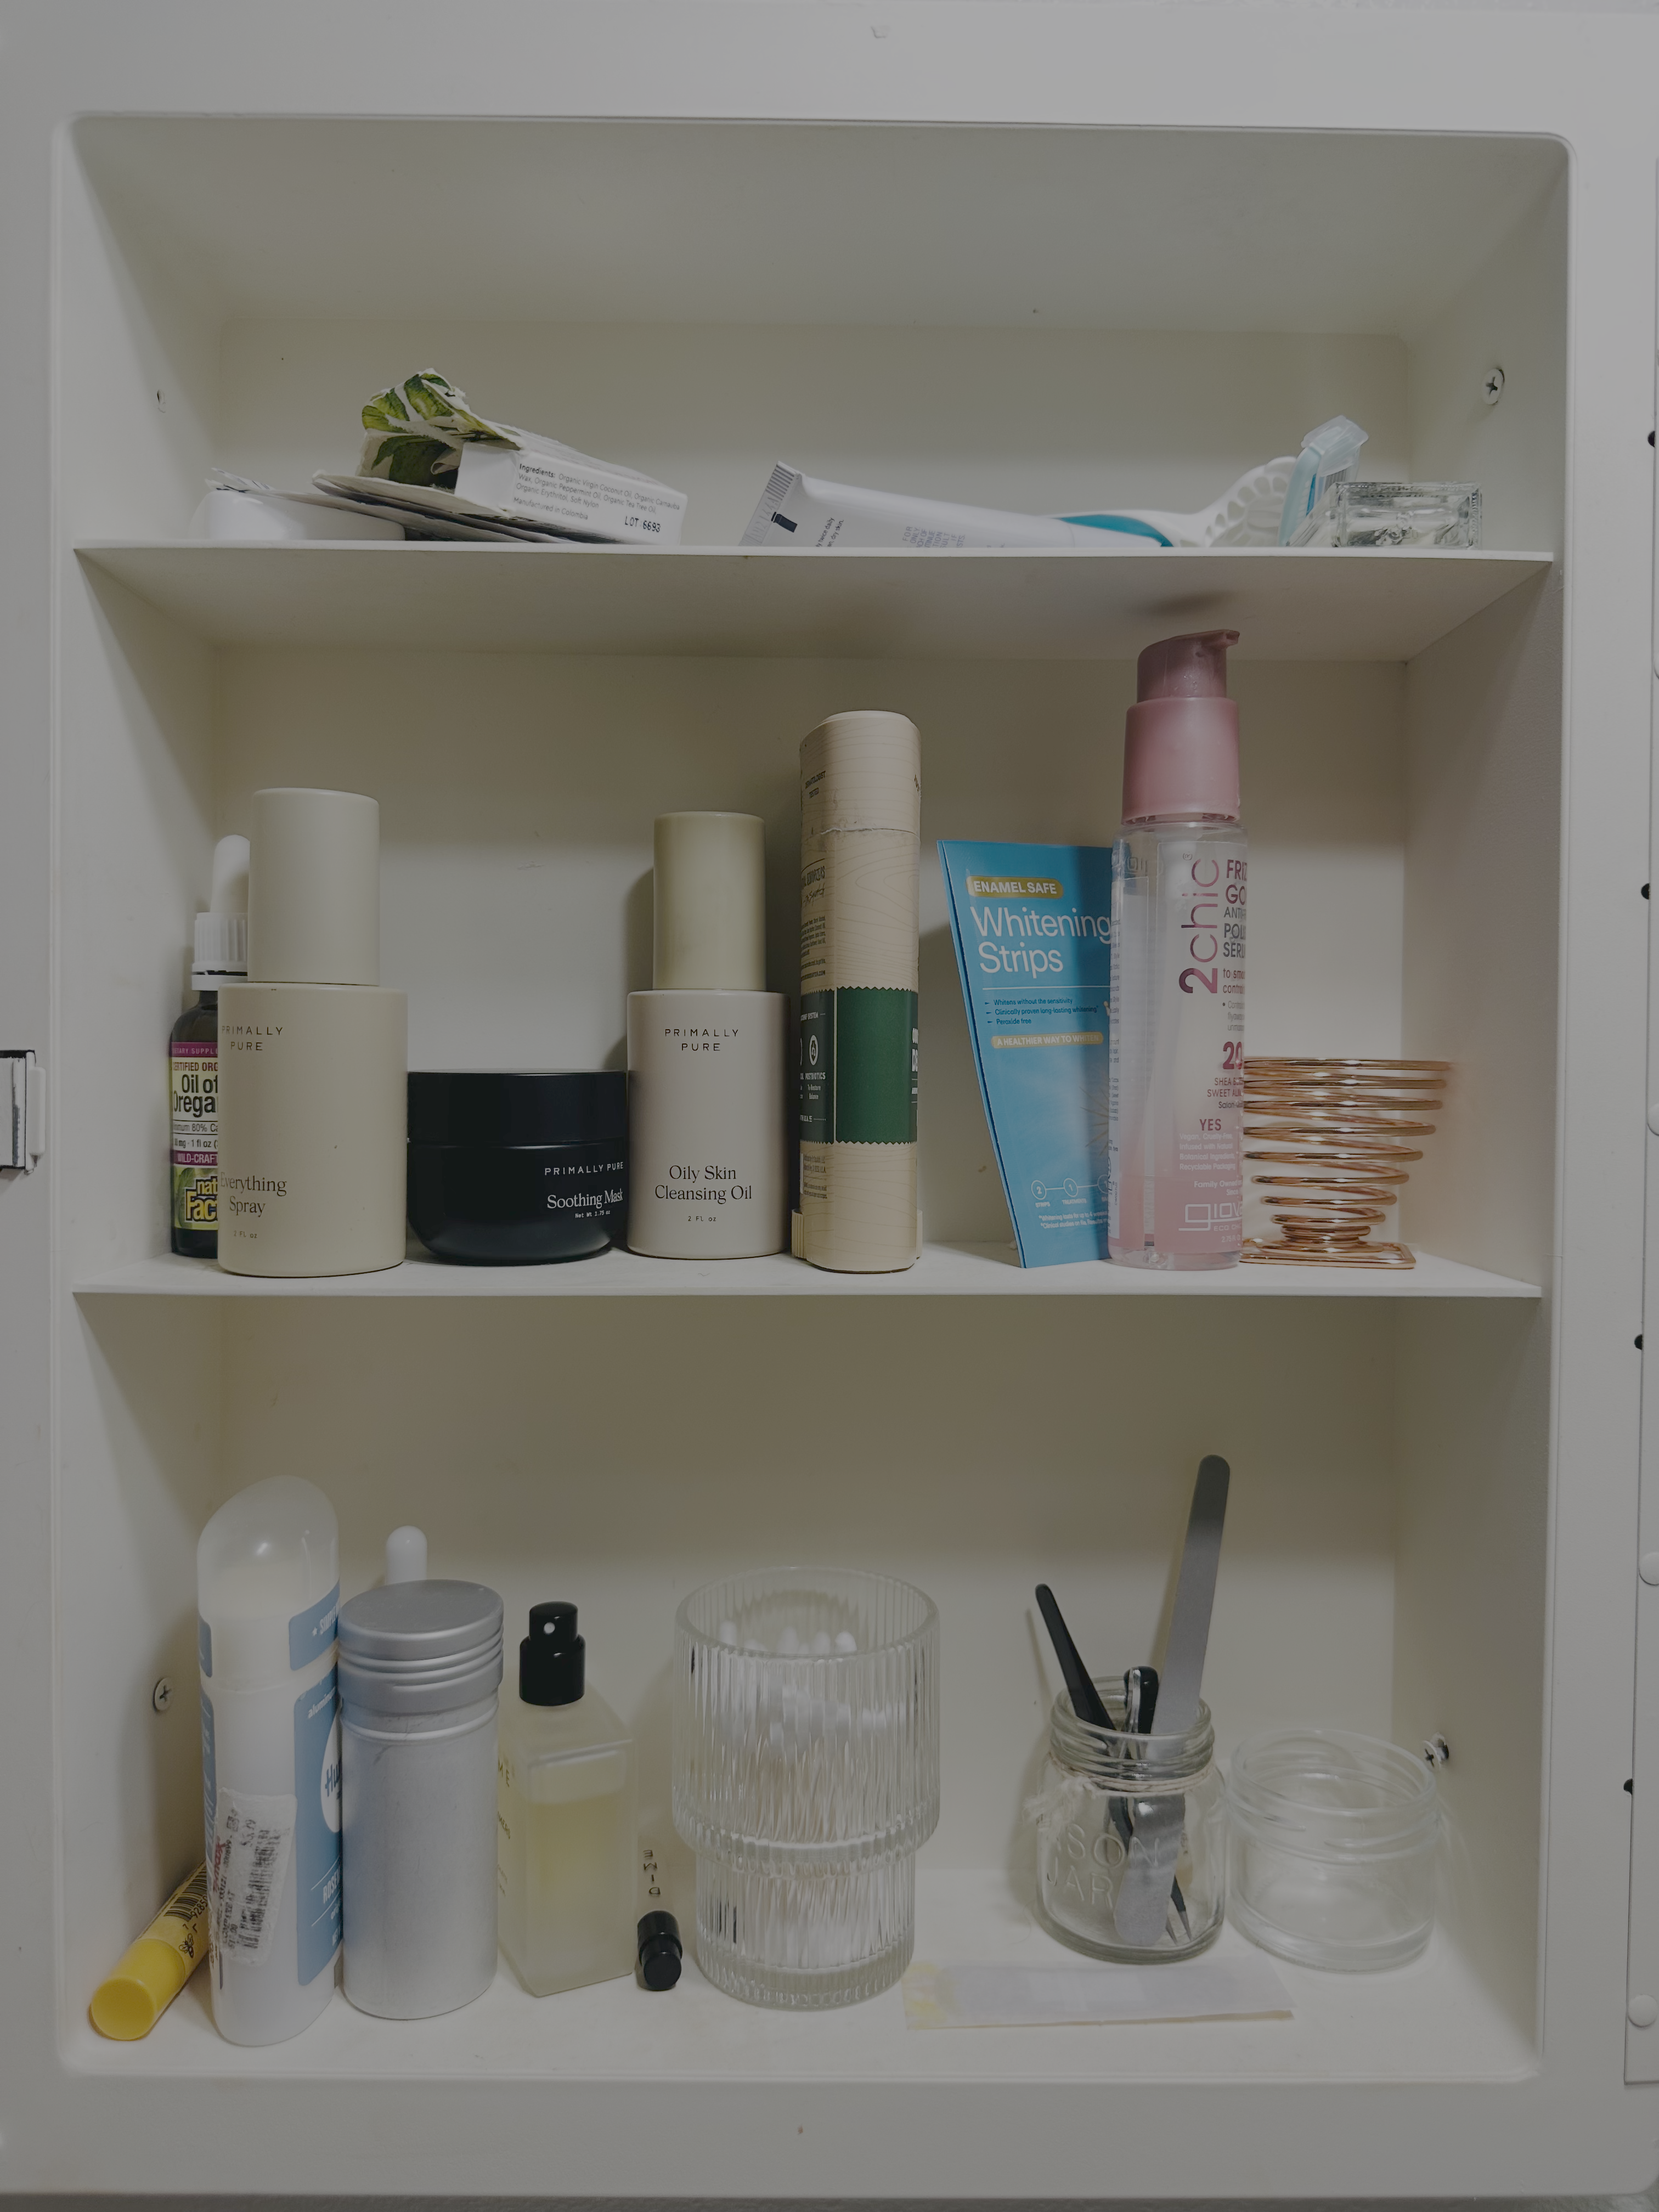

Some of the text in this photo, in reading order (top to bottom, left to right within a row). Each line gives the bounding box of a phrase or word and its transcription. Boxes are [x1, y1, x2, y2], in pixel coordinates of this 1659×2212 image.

[518, 473, 532, 483] Wax,
[535, 477, 557, 489] Organic
[560, 483, 591, 498] Peppermint
[593, 492, 601, 500] Oil,
[603, 495, 624, 506] Organic
[636, 503, 647, 511] Tree
[519, 464, 555, 478] Ingredients:
[559, 473, 581, 486] Organic
[583, 479, 598, 489] Virgin
[600, 484, 623, 495] Coconut
[634, 493, 658, 505] Organic
[516, 483, 538, 494] Organic
[571, 496, 582, 504] Soft
[583, 499, 599, 509] Nylon
[514, 497, 553, 511] Manufactured
[562, 508, 588, 520] Colombia
[643, 521, 661, 532] 6693
[920, 529, 928, 538] OF
[973, 881, 1057, 894] ENAMEL SAFE
[969, 906, 1111, 945] Whitening
[1179, 859, 1220, 994] 2chic
[978, 941, 1064, 979] Strips
[1223, 968, 1231, 978] to
[1040, 1007, 1071, 1015] long-lasting
[222, 1025, 283, 1035] PRIMALLY
[665, 1029, 738, 1037] PRIMALLY
[230, 1041, 263, 1051] PURE
[681, 1043, 720, 1051] PURE
[1003, 1037, 1042, 1046] HEALTHIER
[1043, 1036, 1060, 1044] WAY
[1072, 1034, 1099, 1043] WHITEN
[182, 1074, 199, 1093] Oil
[1207, 1089, 1230, 1097] SWEET
[173, 1090, 218, 1118] Orega
[192, 1123, 207, 1132] 80%
[1199, 1119, 1221, 1131] YES
[545, 1161, 623, 1176] PRIMALLY PURE
[669, 1165, 737, 1183] Oily Skin
[1180, 1163, 1212, 1171] Recyclable
[221, 1172, 286, 1197] Everything
[1036, 1186, 1042, 1194] 2
[1194, 1181, 1217, 1189] Family
[547, 1188, 623, 1209] Soothing Mask
[655, 1184, 752, 1205] Cleansing Oil
[229, 1195, 266, 1217] Spray
[1058, 1822, 1159, 1869] SON
[1047, 1856, 1113, 1911] JAR
